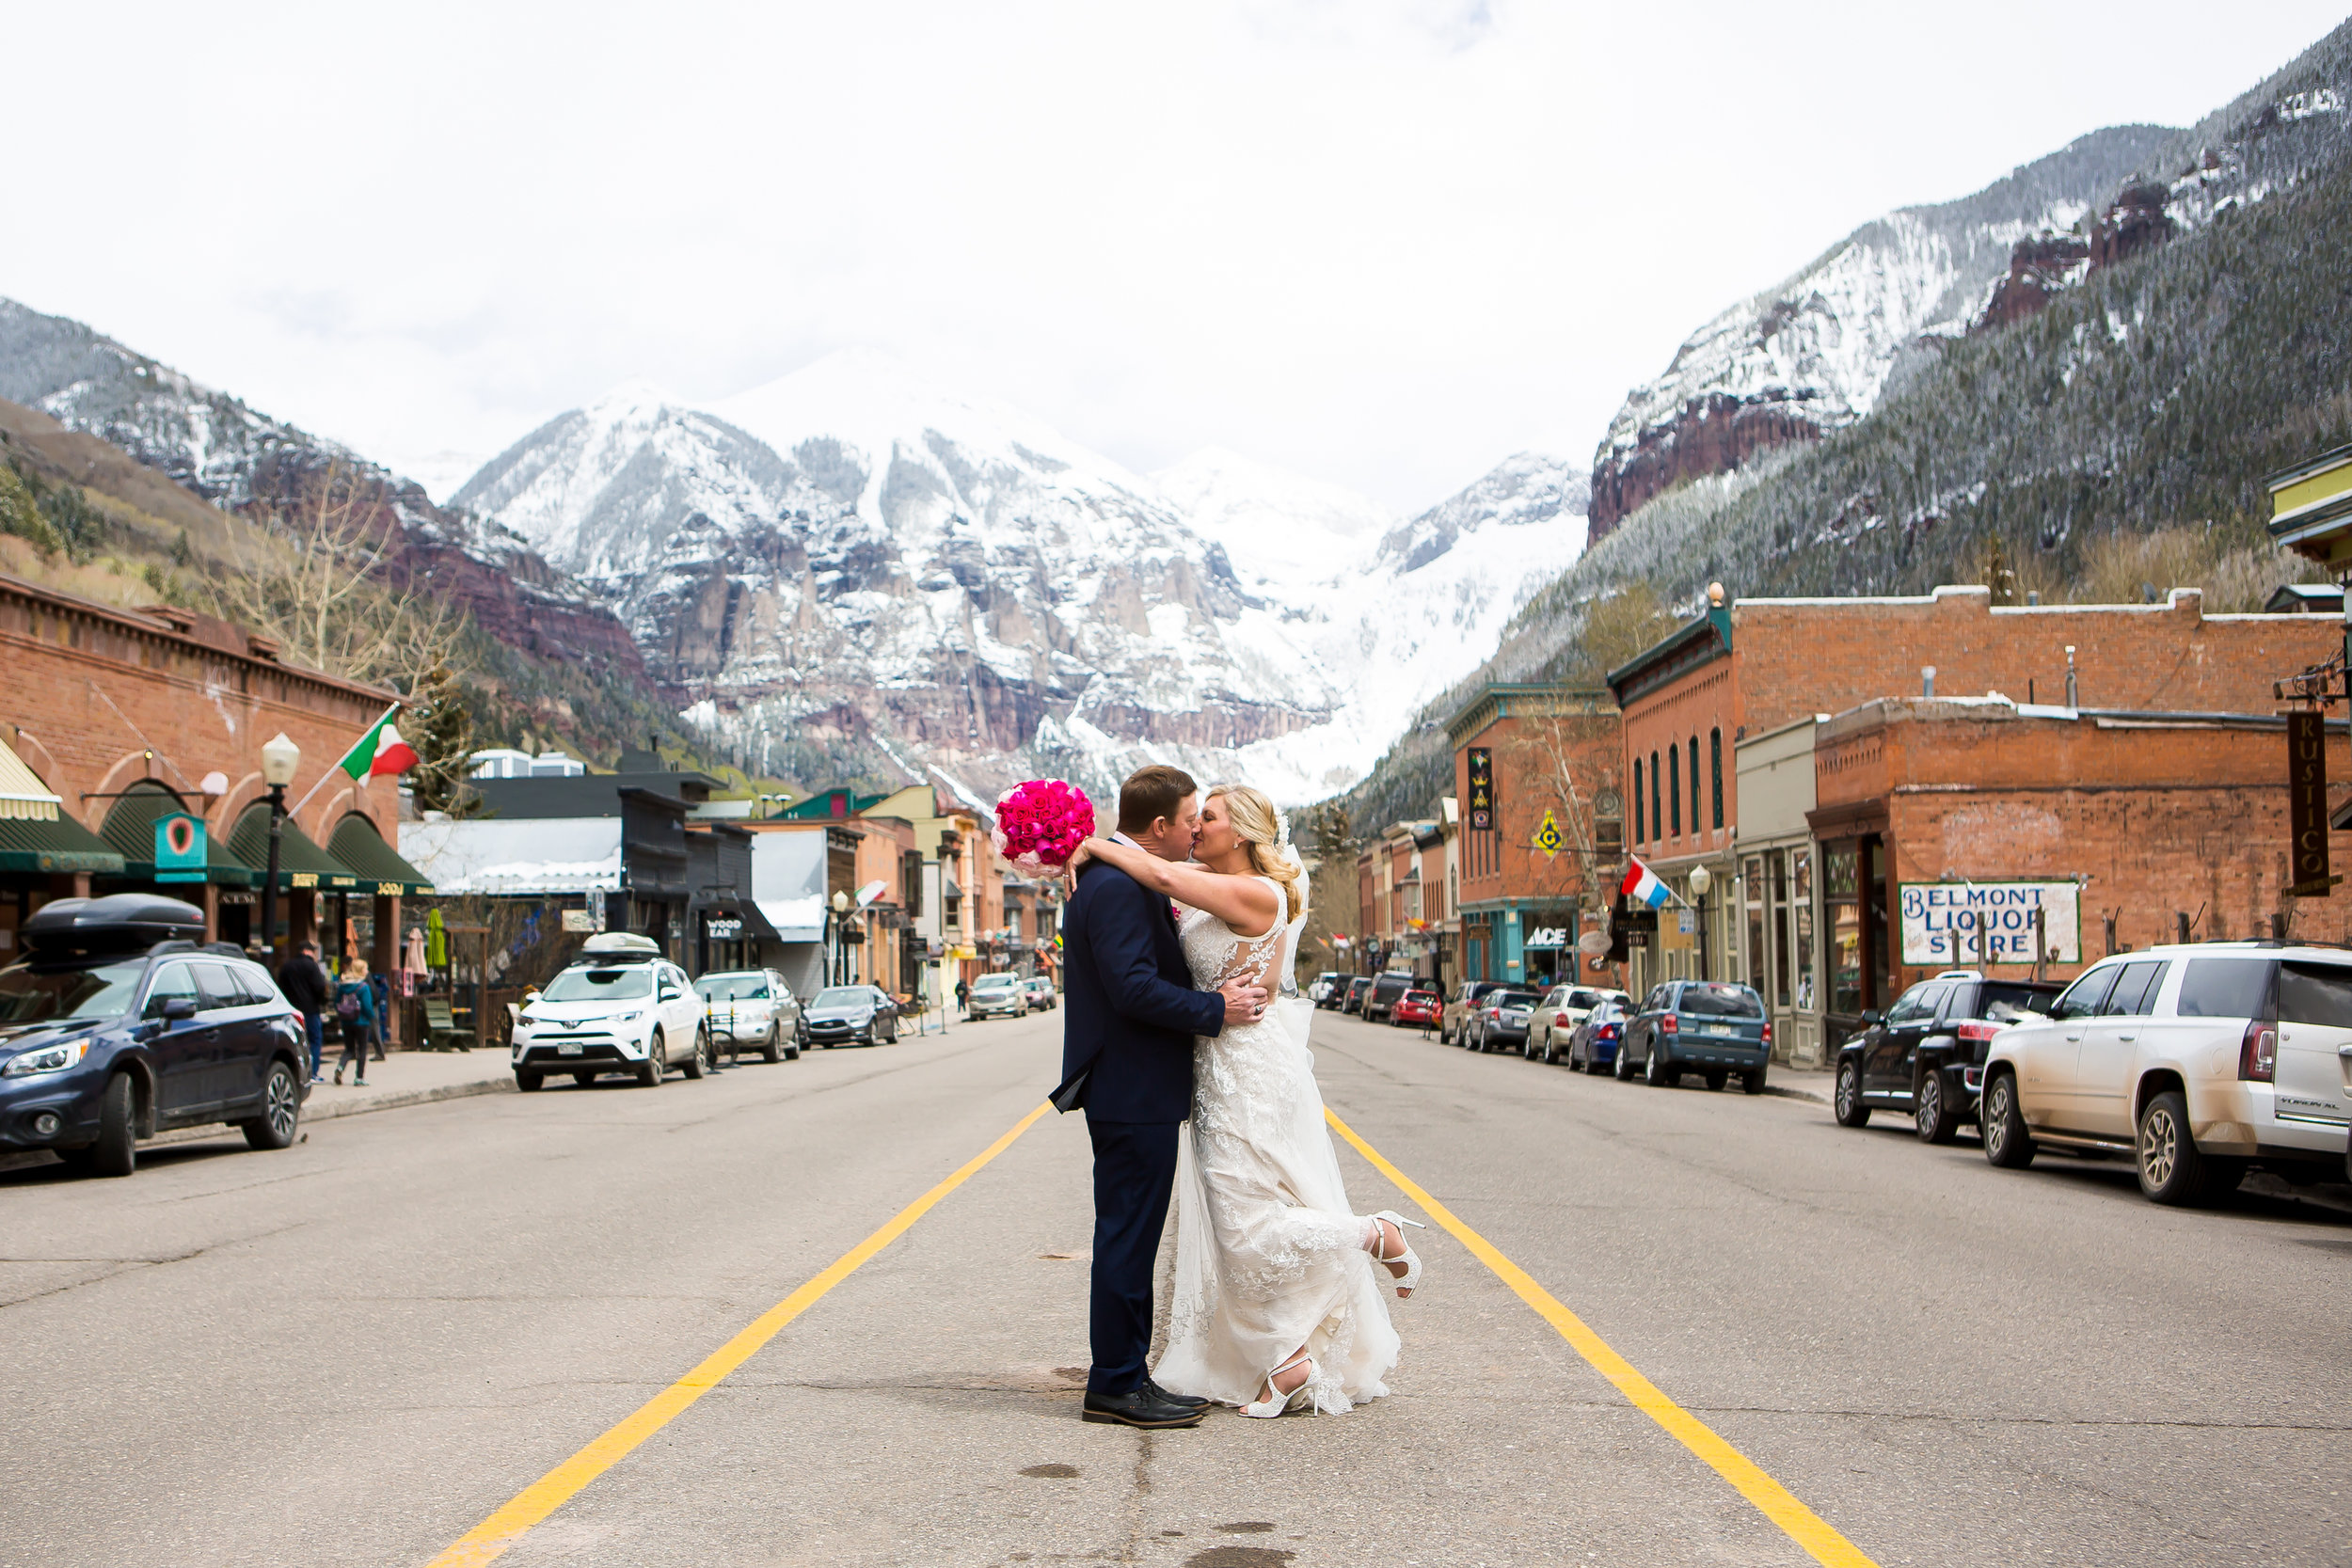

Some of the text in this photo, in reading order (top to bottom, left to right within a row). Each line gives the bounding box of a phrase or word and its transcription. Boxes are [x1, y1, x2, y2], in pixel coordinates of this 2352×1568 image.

[2299, 717, 2323, 873] RUSTICO
[1903, 888, 2046, 919] BELMONT
[707, 920, 742, 929] WOOD
[709, 928, 731, 938] EAR
[1527, 927, 1566, 945] ACE
[1931, 935, 2028, 954] SORE
